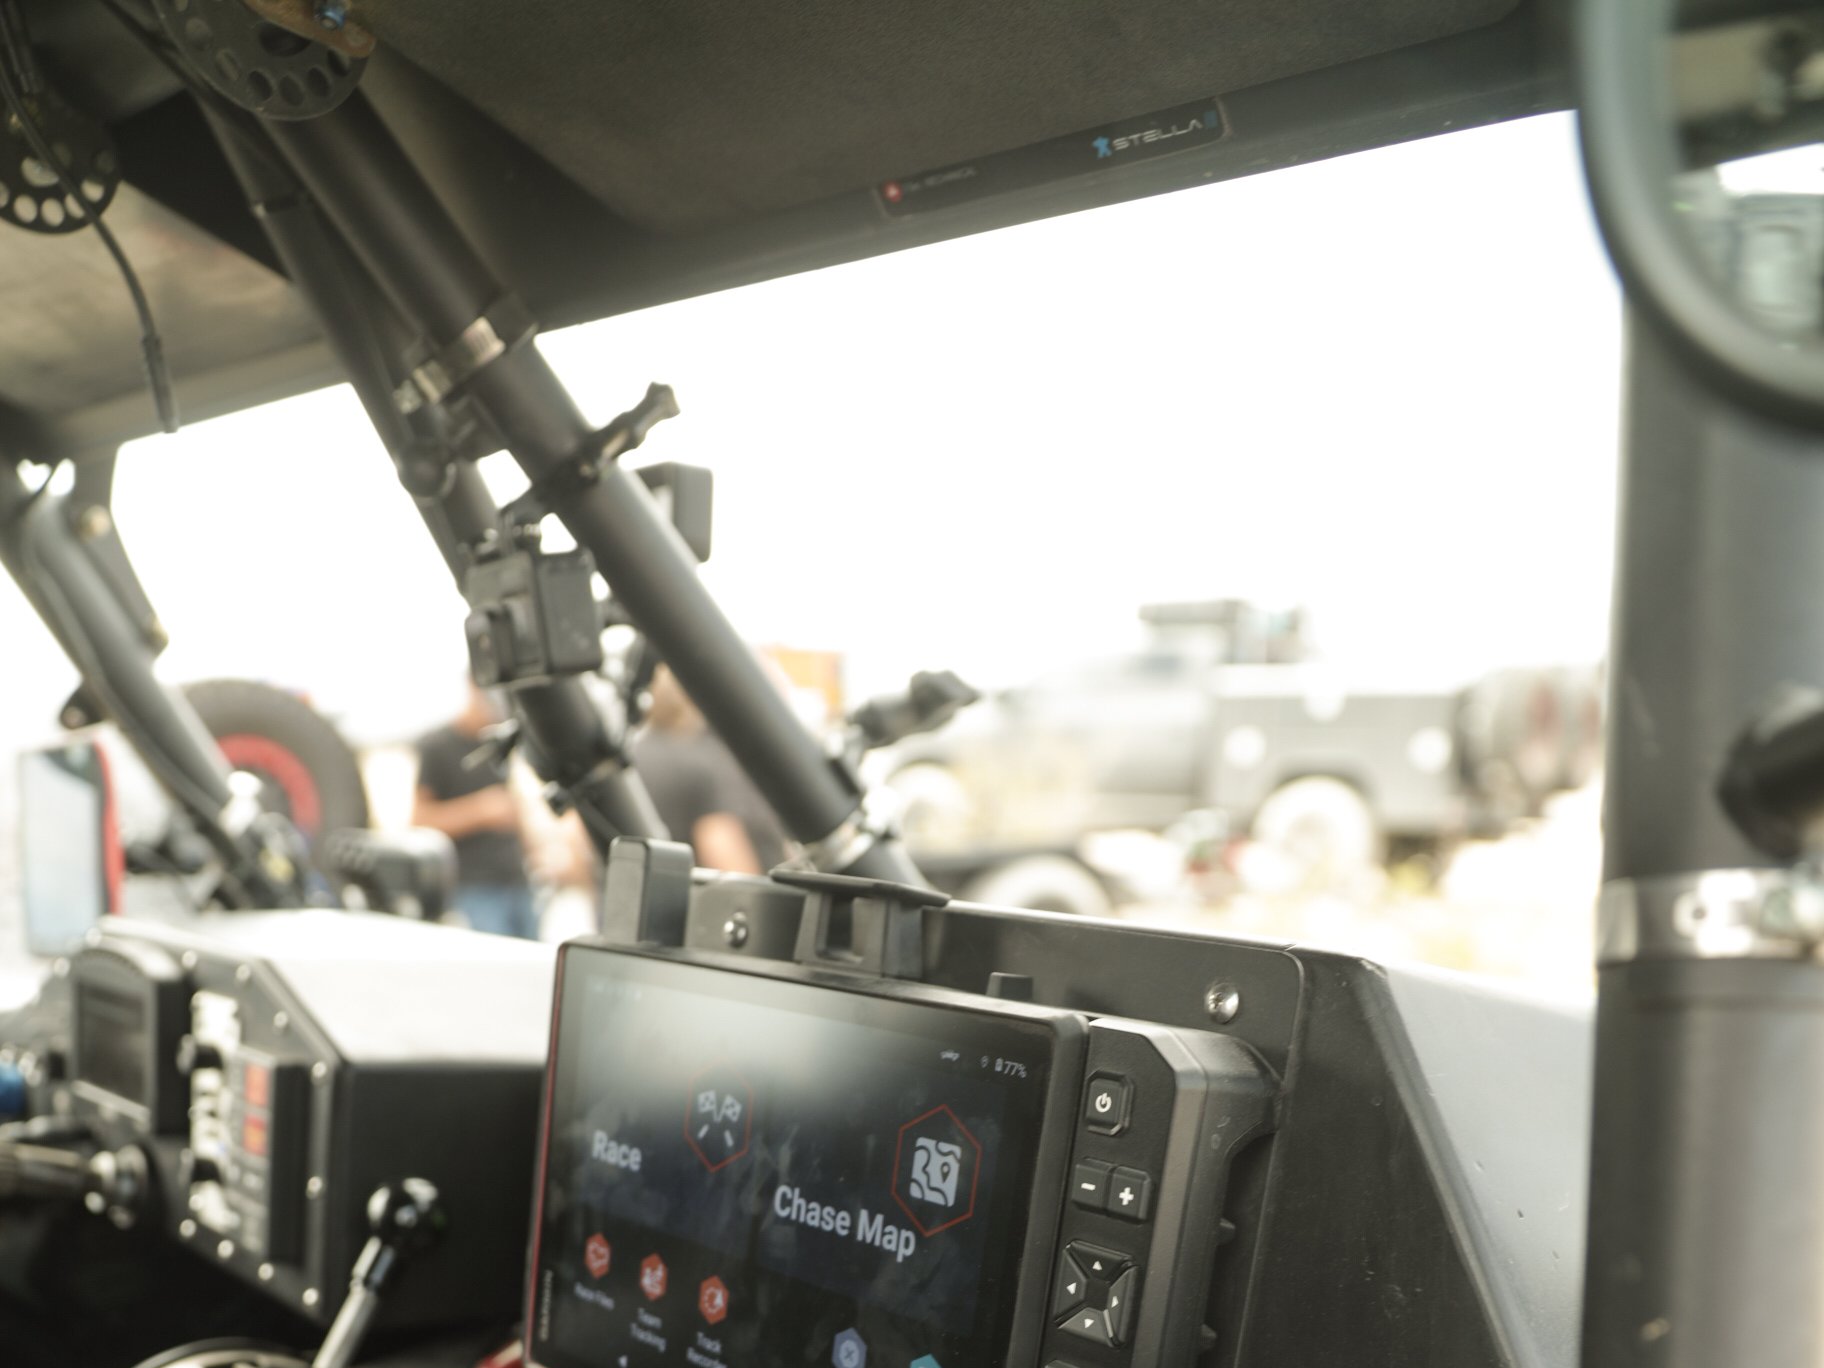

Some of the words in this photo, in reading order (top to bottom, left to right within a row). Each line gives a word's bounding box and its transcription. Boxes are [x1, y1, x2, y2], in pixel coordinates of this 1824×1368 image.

[1112, 118, 1203, 151] STELLA
[1004, 1060, 1028, 1079] 77%
[592, 1130, 642, 1172] Race
[774, 1184, 851, 1237] Chase
[856, 1208, 917, 1263] Map
